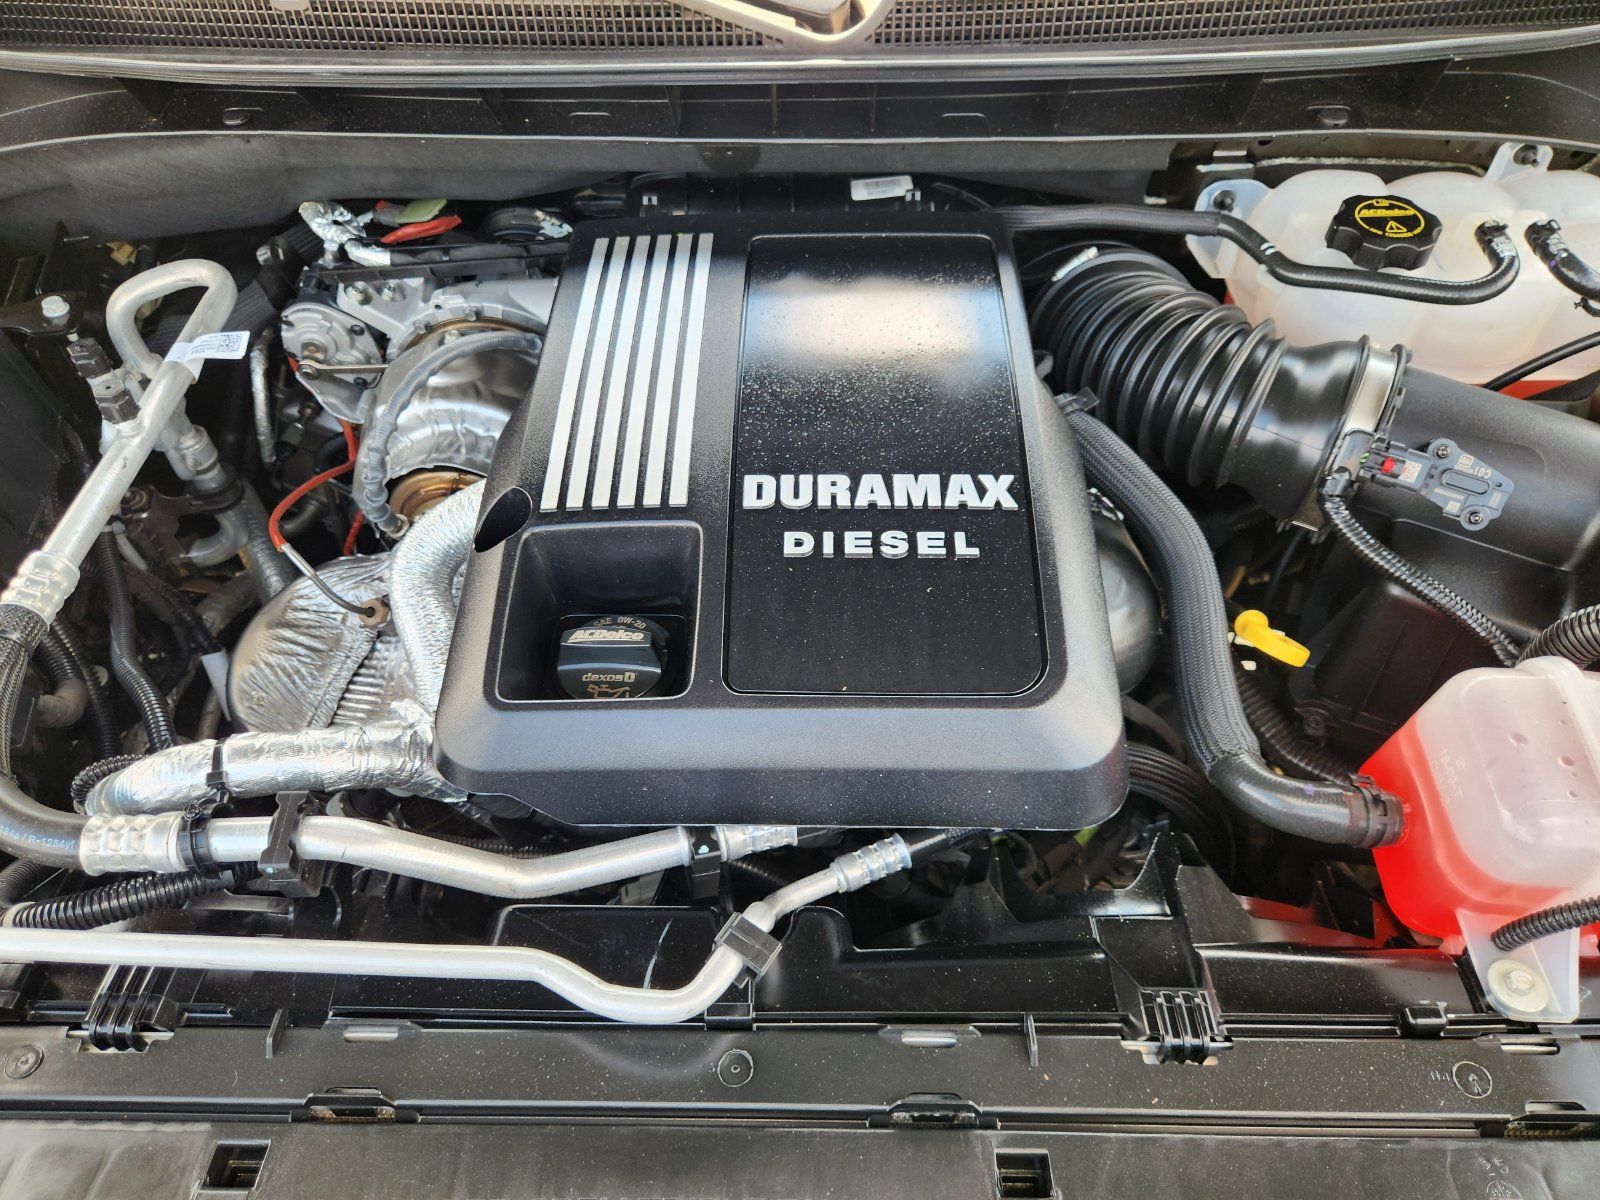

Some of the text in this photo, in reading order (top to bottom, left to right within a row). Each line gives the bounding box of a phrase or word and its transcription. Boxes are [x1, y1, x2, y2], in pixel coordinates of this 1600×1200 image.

[743, 474, 1018, 510] DURAMAX
[783, 531, 980, 558] DIESEL
[567, 630, 645, 642] ACDelco
